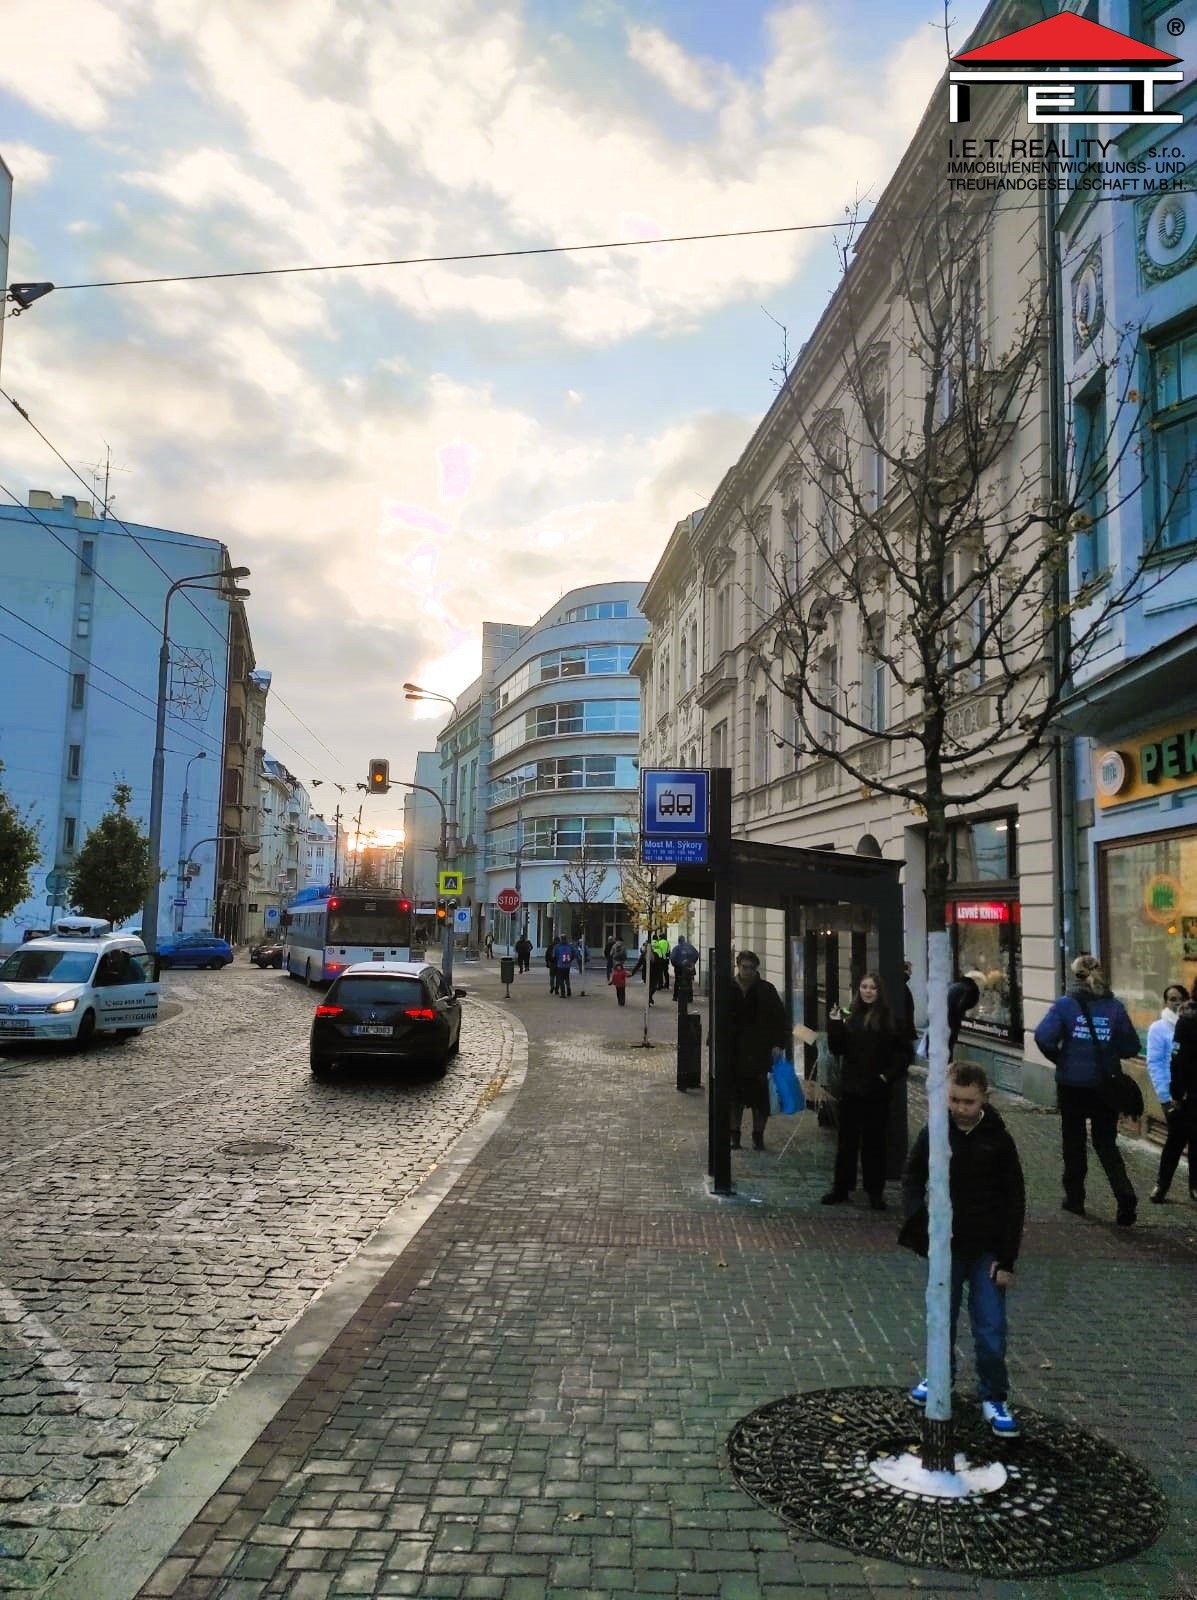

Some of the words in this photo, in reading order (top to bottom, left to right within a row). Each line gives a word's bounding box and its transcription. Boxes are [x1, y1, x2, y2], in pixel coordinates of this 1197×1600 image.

[644, 840, 664, 848] Most
[665, 840, 675, 849] M.
[677, 840, 703, 851] Sýkory
[498, 895, 519, 905] STOP
